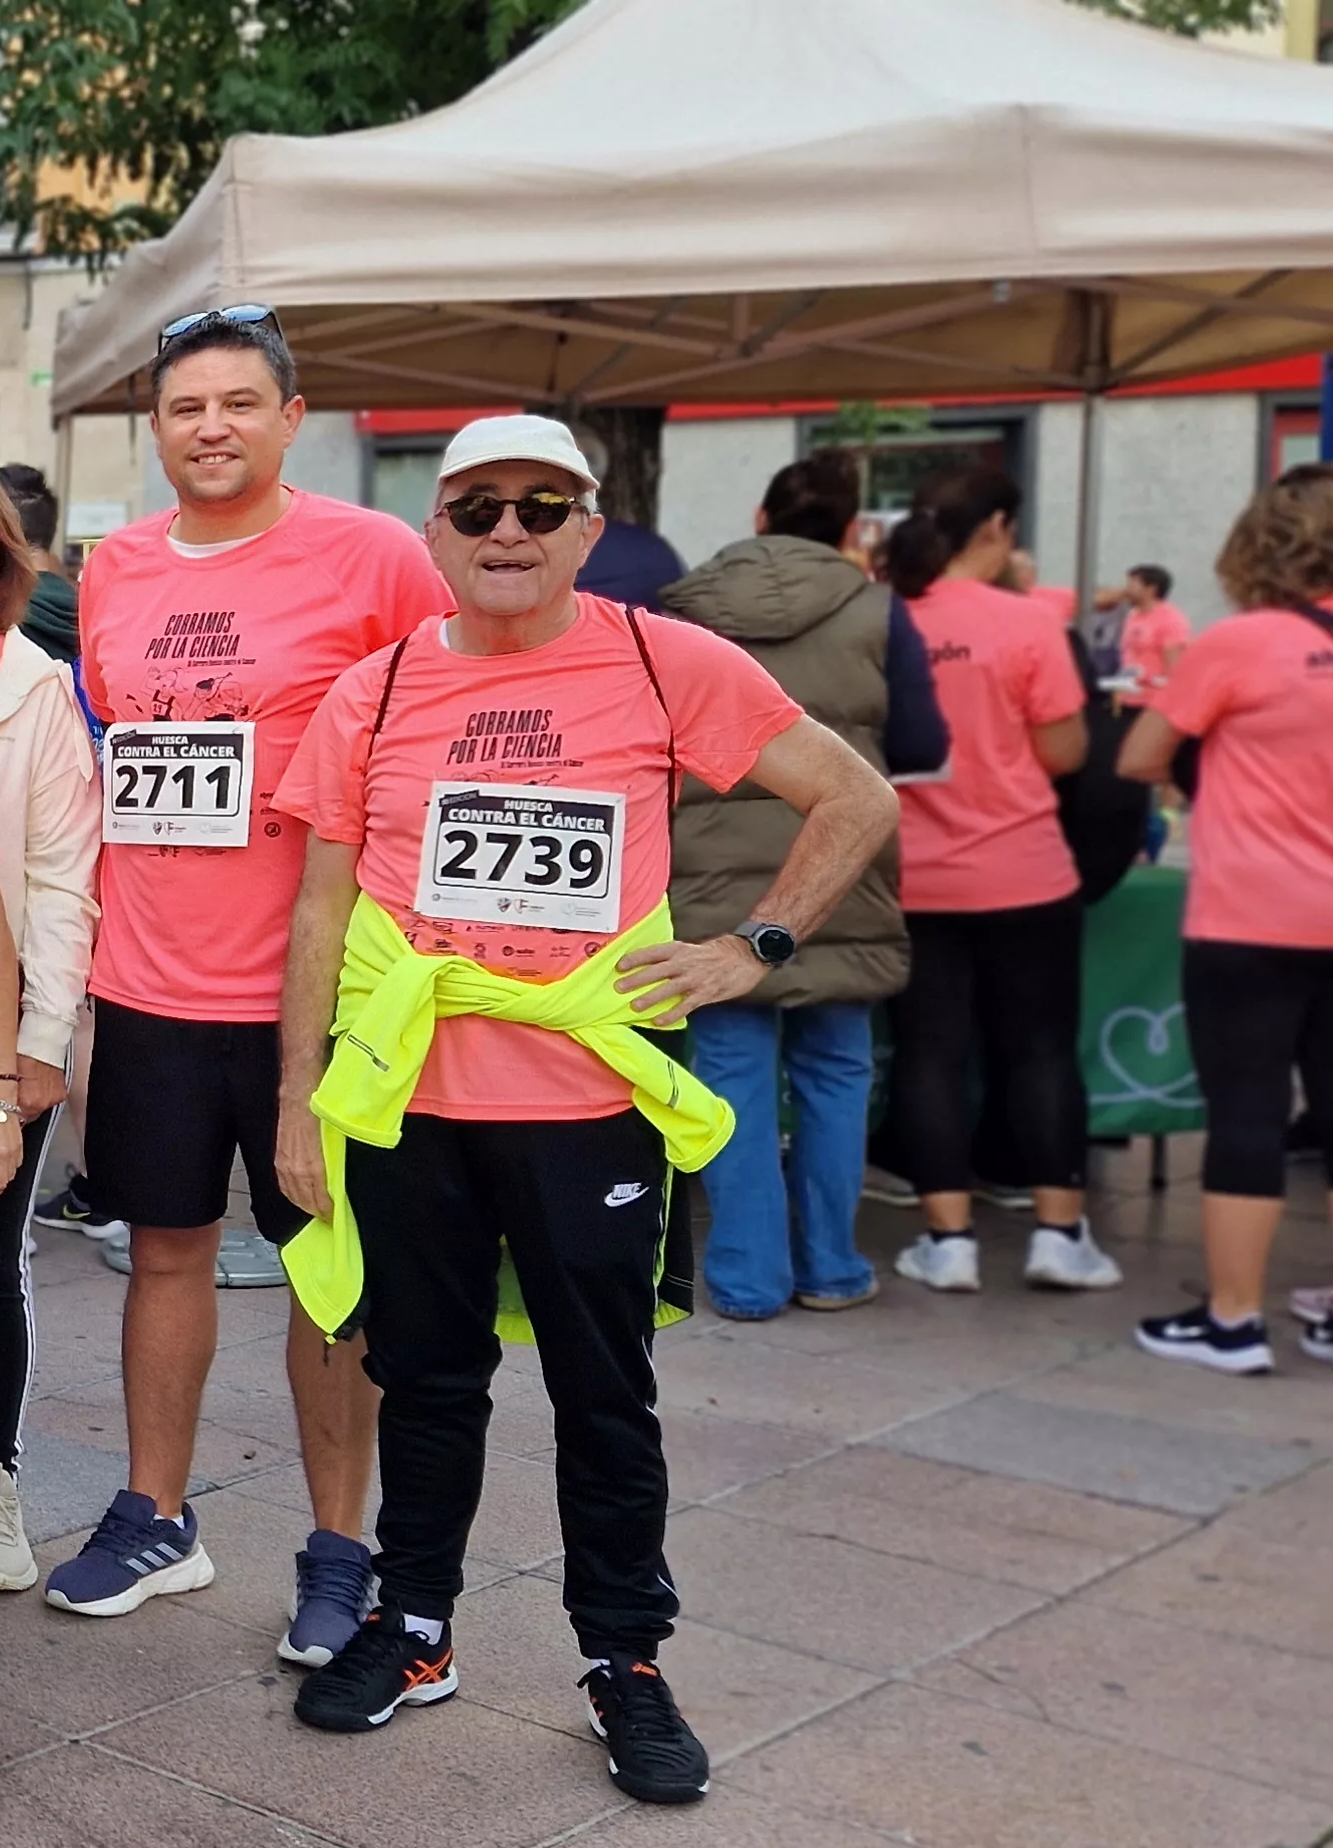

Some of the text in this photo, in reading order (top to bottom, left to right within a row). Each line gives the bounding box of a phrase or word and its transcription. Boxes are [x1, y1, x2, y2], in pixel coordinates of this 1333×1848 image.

[164, 611, 236, 636] CORRAMOS
[144, 634, 241, 660] POR LA CIENCIA
[465, 709, 553, 738] CORRAMOS
[118, 743, 235, 757] CONTRA EL CÁNCER
[151, 735, 188, 745] HUESCA
[446, 733, 563, 765] POR LA CIENCIA
[115, 765, 231, 809] 2711
[504, 800, 554, 813] HUESCA
[448, 808, 605, 832] CONTRA EL CÁNCER
[440, 830, 604, 889] 2739
[612, 1182, 642, 1199] NIKE
